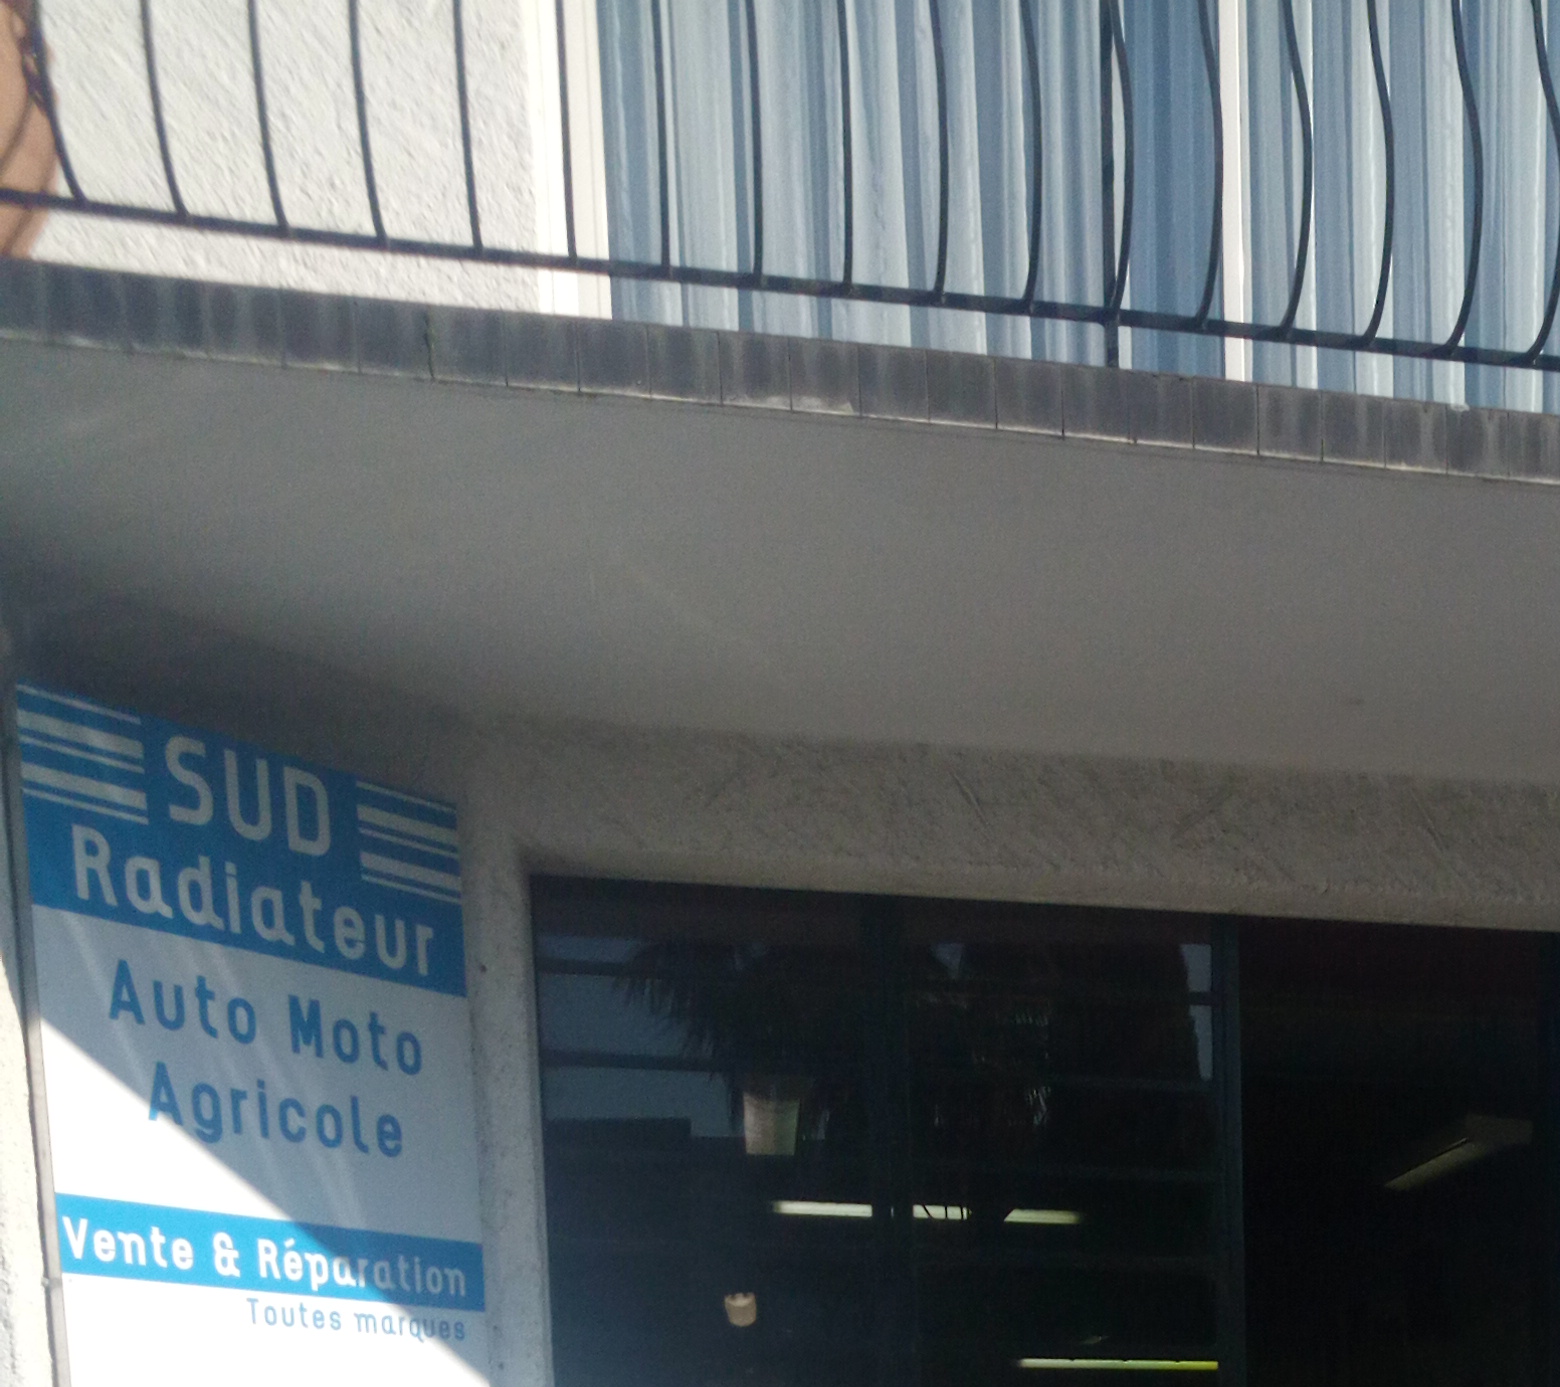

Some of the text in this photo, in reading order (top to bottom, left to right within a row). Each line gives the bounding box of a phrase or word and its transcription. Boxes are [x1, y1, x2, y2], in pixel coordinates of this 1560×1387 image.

[164, 735, 332, 857] SUD
[71, 824, 435, 977] Radiateur
[109, 959, 424, 1077] Auto Moto
[148, 1061, 404, 1158] Agricole
[62, 1216, 467, 1297] Vente & Réparation
[246, 1299, 466, 1342] Toutes marques
